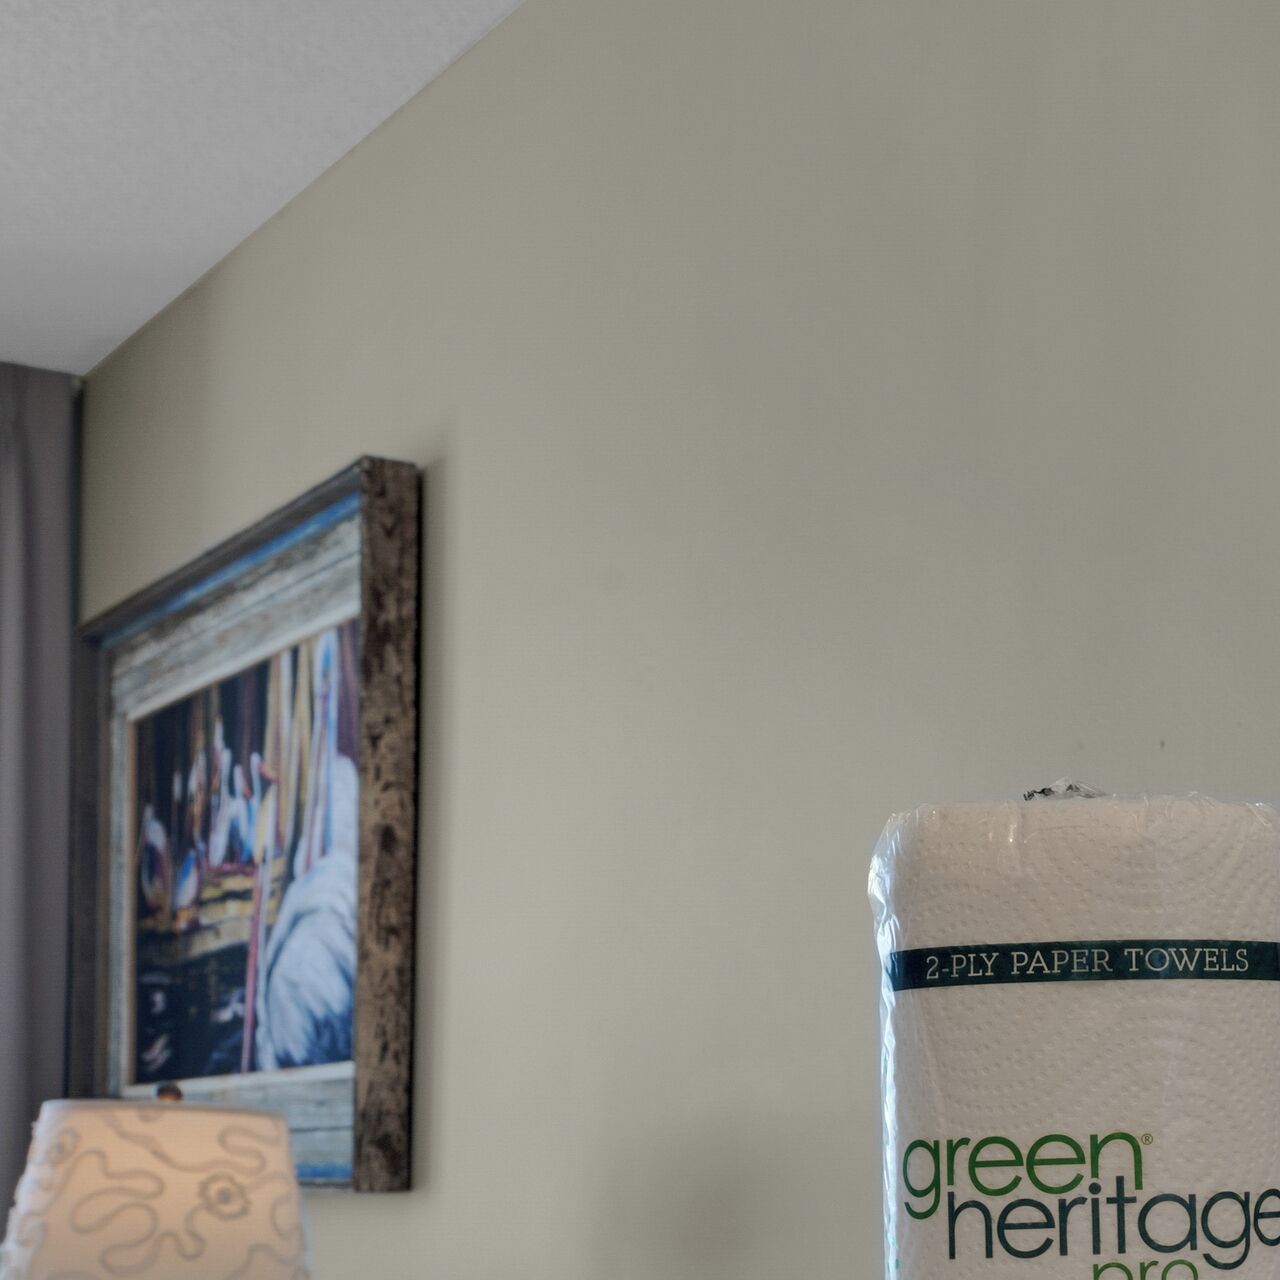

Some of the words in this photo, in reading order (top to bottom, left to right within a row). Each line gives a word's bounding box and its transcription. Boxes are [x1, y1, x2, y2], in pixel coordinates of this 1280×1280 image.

[926, 951, 1000, 980] 2-PLY
[1011, 948, 1113, 975] PAPER
[1124, 947, 1250, 973] TOWELS
